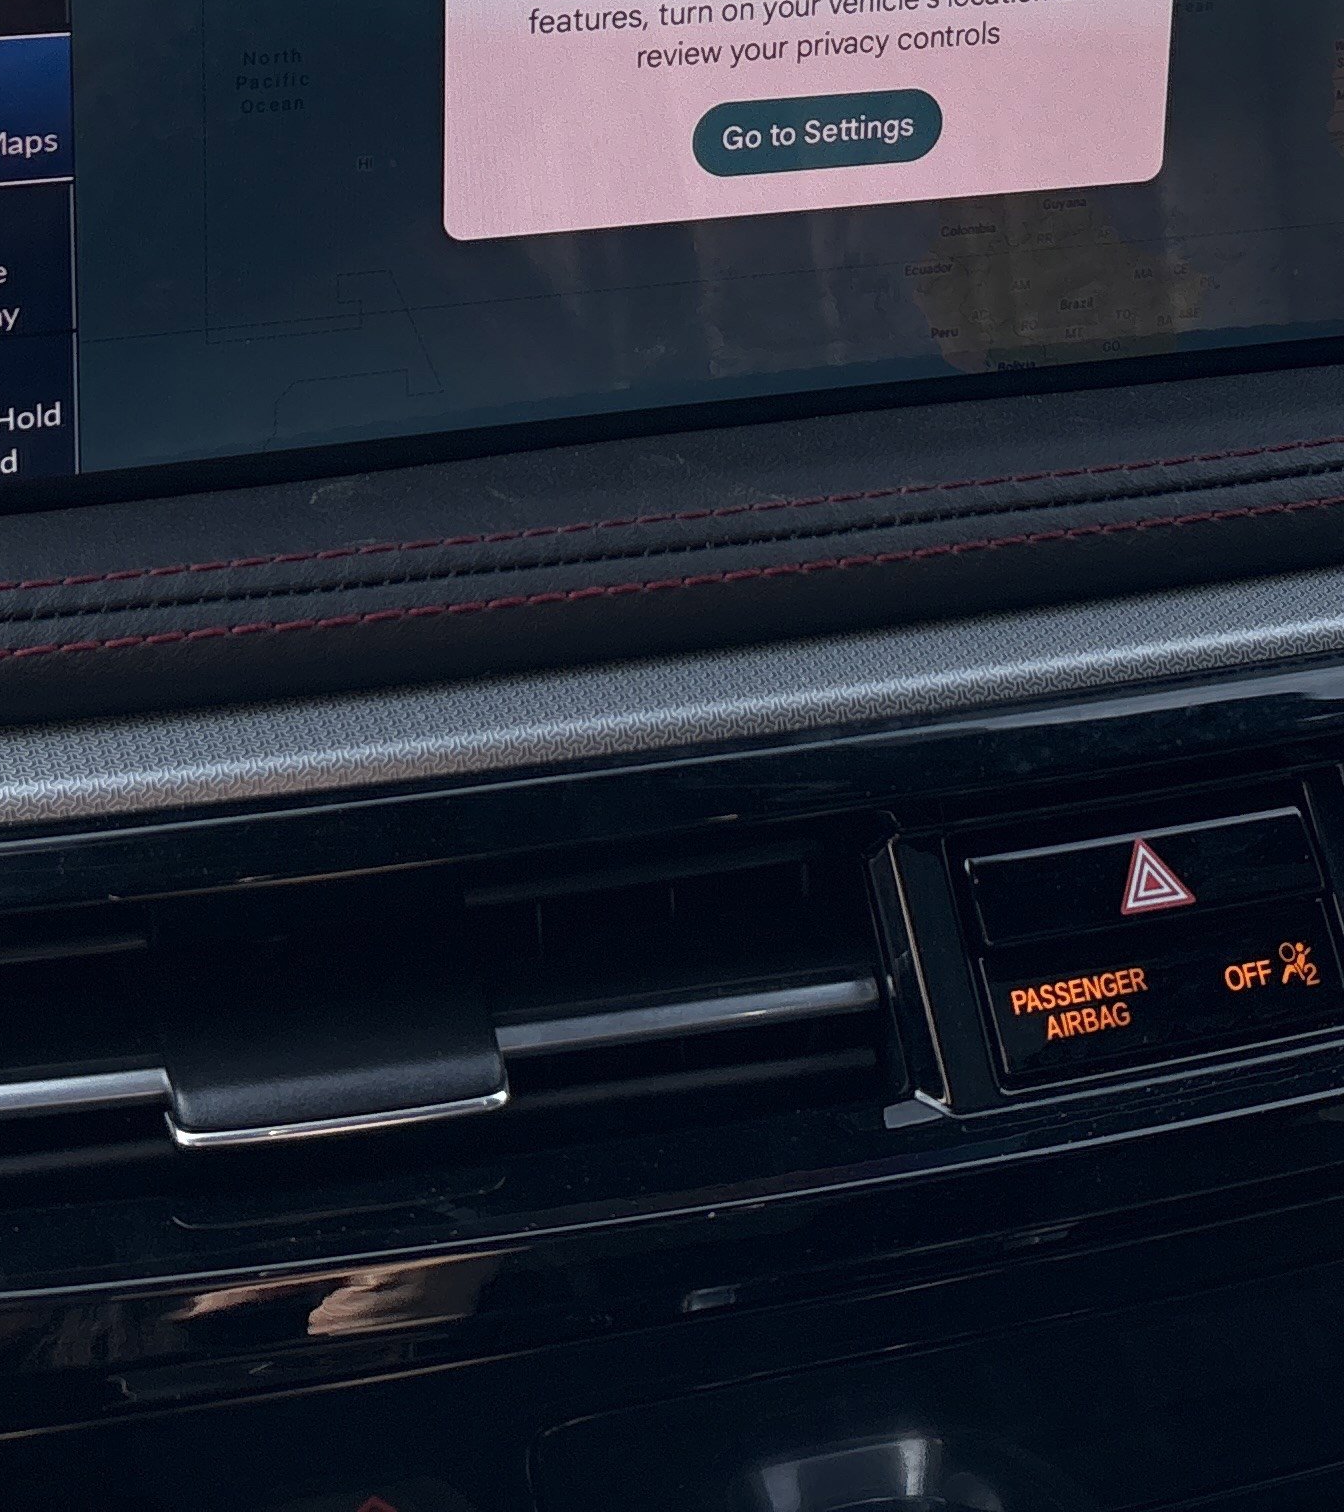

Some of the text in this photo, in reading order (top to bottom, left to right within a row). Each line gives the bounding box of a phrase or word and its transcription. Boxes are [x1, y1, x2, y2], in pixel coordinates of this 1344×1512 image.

[528, 6, 649, 35] features,
[658, 0, 714, 25] turn
[721, 0, 755, 21] on
[636, 20, 1001, 69] review your privacy controls
[242, 48, 304, 66] North
[236, 72, 311, 90] Pacific
[241, 97, 305, 115] Ocean
[722, 113, 915, 152] Go to Settings
[1043, 197, 1087, 211] Guyana
[941, 223, 996, 237] Colombia
[905, 262, 953, 276] Ecuador
[1060, 297, 1094, 311] Brazil
[931, 326, 959, 340] Peru
[1224, 959, 1273, 993] OFF
[1011, 968, 1148, 1015] PASSENGER
[1045, 1001, 1131, 1041] AIRBAG
